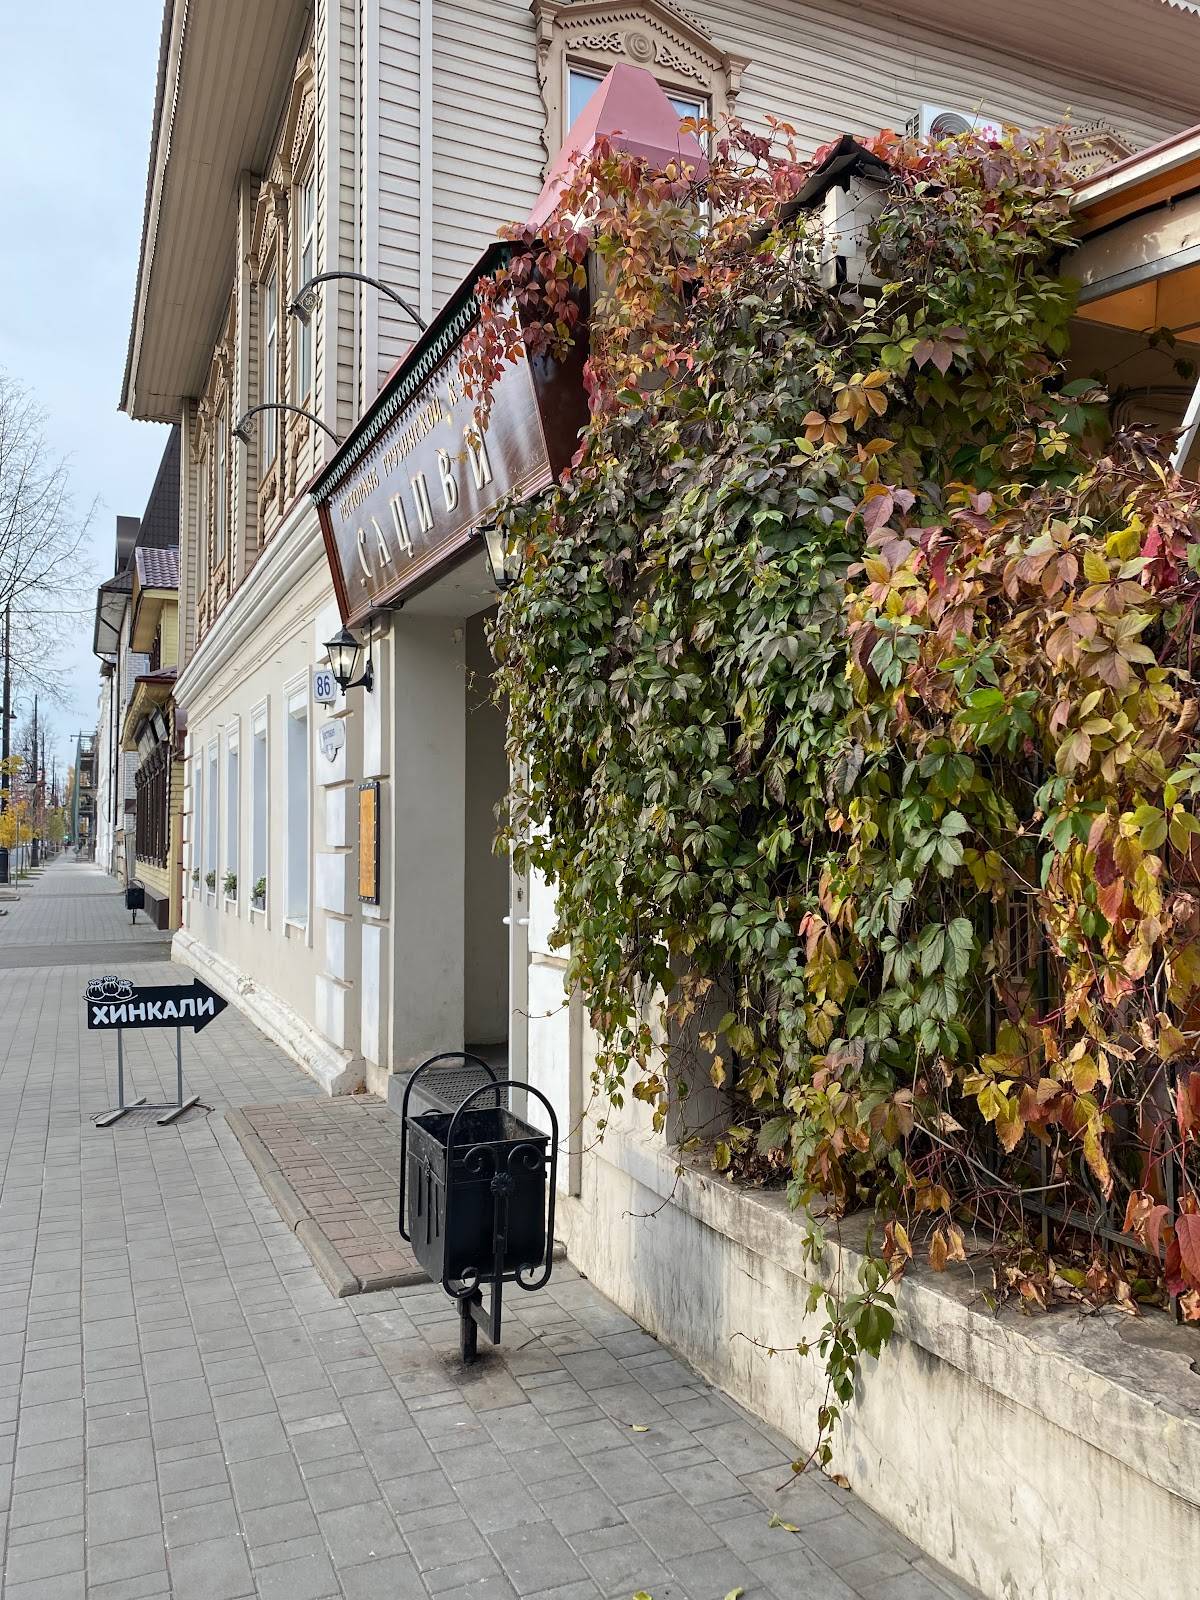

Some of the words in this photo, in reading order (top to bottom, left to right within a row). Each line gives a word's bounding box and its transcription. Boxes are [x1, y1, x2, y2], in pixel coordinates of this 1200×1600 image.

[357, 419, 493, 588] САЦИВИ
[317, 675, 331, 697] 86
[92, 996, 215, 1025] ХИНКАЛИ
